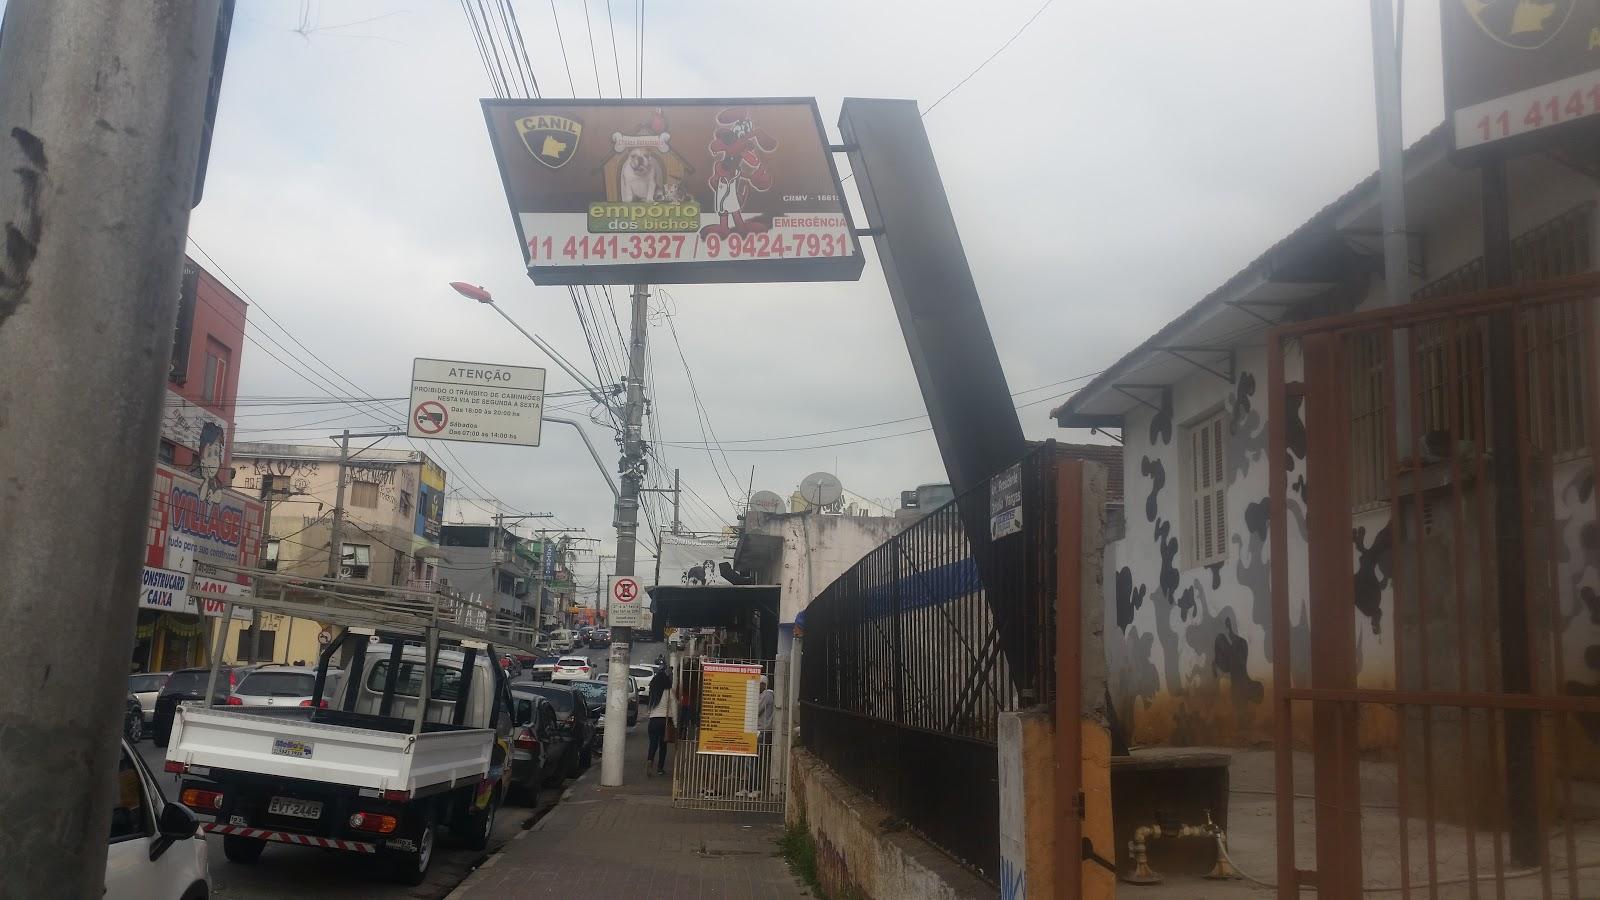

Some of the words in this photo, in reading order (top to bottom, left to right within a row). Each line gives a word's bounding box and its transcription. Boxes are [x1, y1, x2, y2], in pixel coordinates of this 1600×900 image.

[523, 116, 577, 133] CANIL
[1477, 110, 1510, 141] 11
[590, 201, 698, 221] empório
[608, 219, 639, 230] dos
[644, 219, 699, 230] bichos
[774, 216, 847, 228] EMERGÊNCIA
[528, 236, 553, 261] 11
[563, 235, 686, 260] 4141-3327
[706, 233, 721, 258] 9
[728, 231, 848, 258] 9424-7931
[448, 367, 512, 382] ATENÇÃO
[414, 386, 447, 394] PROIBIDO
[456, 388, 488, 397] TRÂNSITO
[501, 393, 541, 401] CAMINHÕES
[449, 421, 478, 429] Sábados
[172, 486, 242, 548] VILLAGE
[143, 569, 185, 591] ONSTRUCARD
[147, 589, 173, 607] CAIXA
[271, 801, 320, 818] EVT-2445
